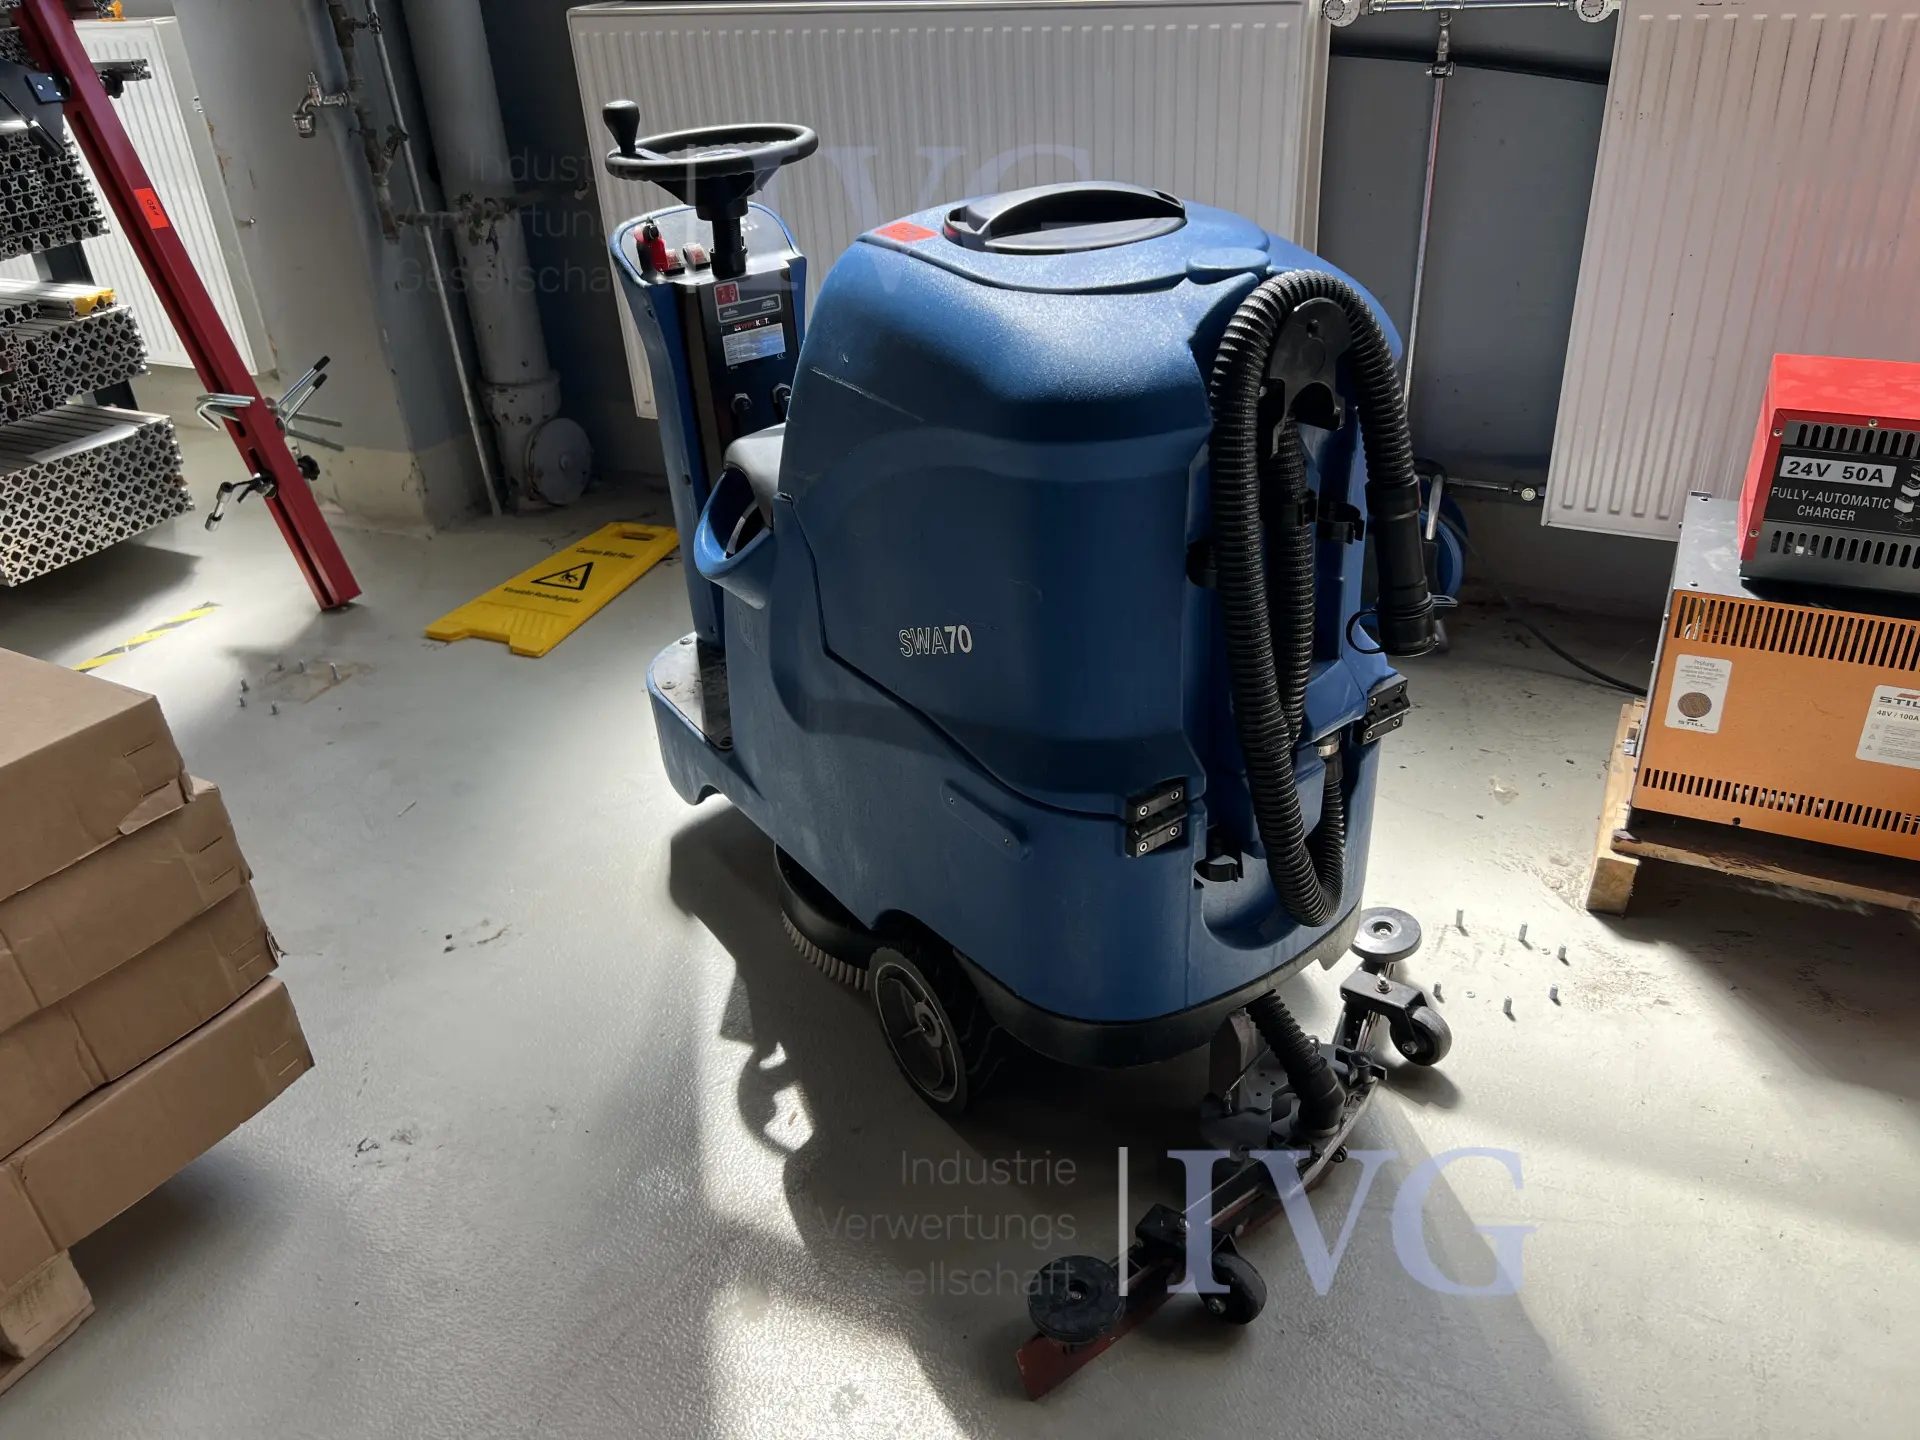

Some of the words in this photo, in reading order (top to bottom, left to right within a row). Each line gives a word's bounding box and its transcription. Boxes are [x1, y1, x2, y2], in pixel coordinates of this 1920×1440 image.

[1787, 461, 1832, 478] 24V
[1841, 466, 1884, 483] 50A
[1771, 486, 1892, 510] FULLY-AUTOMATIC
[1797, 504, 1856, 521] CHARGER
[898, 624, 973, 658] SWA70
[1879, 696, 1920, 709] STIL
[1678, 719, 1706, 728] STILL
[1900, 713, 1919, 721] 100A
